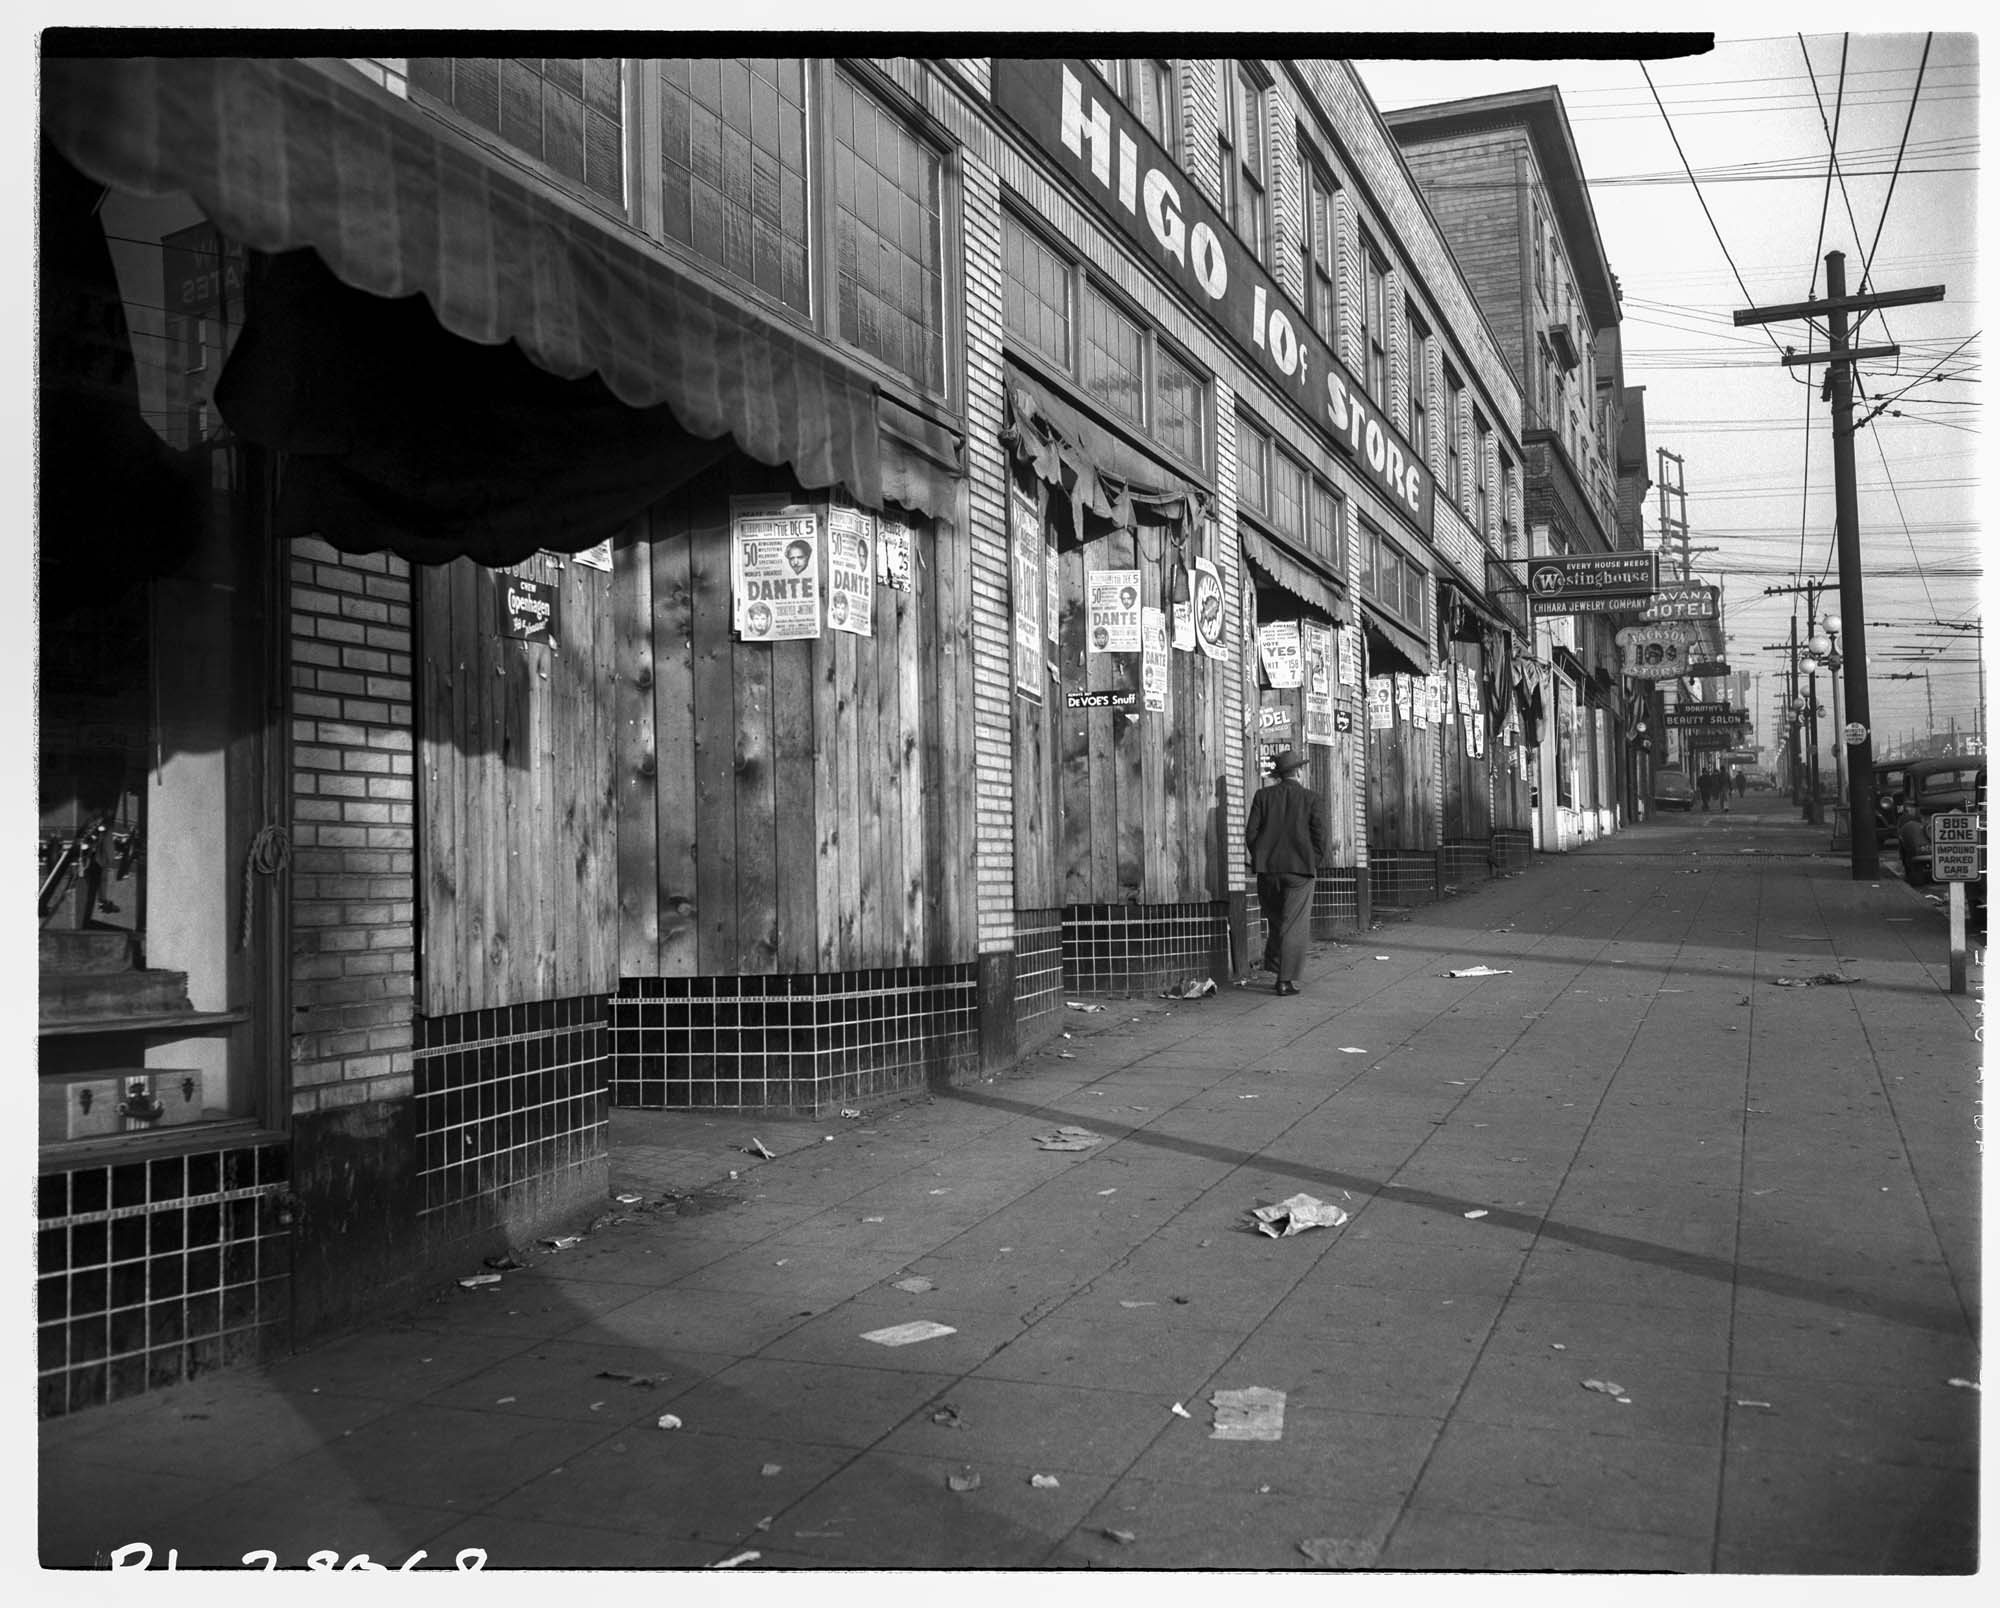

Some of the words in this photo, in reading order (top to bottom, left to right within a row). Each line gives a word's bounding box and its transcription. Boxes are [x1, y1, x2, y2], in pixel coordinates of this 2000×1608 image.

[1060, 63, 1228, 300] HIGO
[1327, 371, 1420, 513] STORE
[789, 519, 804, 537] DEC
[806, 519, 814, 535] 5
[864, 522, 870, 537] 5
[832, 532, 842, 556] 50
[743, 543, 758, 568] 50
[1566, 562, 1591, 570] EVERY
[1594, 561, 1620, 569] HOUSE
[1623, 559, 1649, 567] NEEDS
[834, 569, 870, 597] DANTE
[1133, 574, 1139, 584] 5
[1537, 571, 1649, 589] Westinghouse
[747, 577, 813, 601] DANTE
[1091, 588, 1102, 605] 50
[507, 587, 551, 621] Copenhagen
[1534, 602, 1567, 613] CHIHARA
[1569, 601, 1605, 613] JEWELRY
[1608, 599, 1647, 610] COMPANY
[1646, 602, 1713, 617] HOTEL
[1093, 611, 1137, 626] DANTE
[1632, 630, 1686, 644] JACKSON
[1267, 646, 1297, 657] YES
[1145, 651, 1166, 668] DANTE
[1290, 670, 1296, 680] 7
[1632, 666, 1682, 677] STORE
[1112, 693, 1136, 705] Snuff
[1666, 716, 1704, 725] BEAUTY
[1710, 715, 1742, 725] SALON
[1942, 818, 1969, 829] BUS
[1939, 829, 1974, 841] ZONE
[1937, 846, 1975, 855] IMPOUND
[1938, 855, 1974, 865] PARKED
[1944, 865, 1969, 874] CARS
